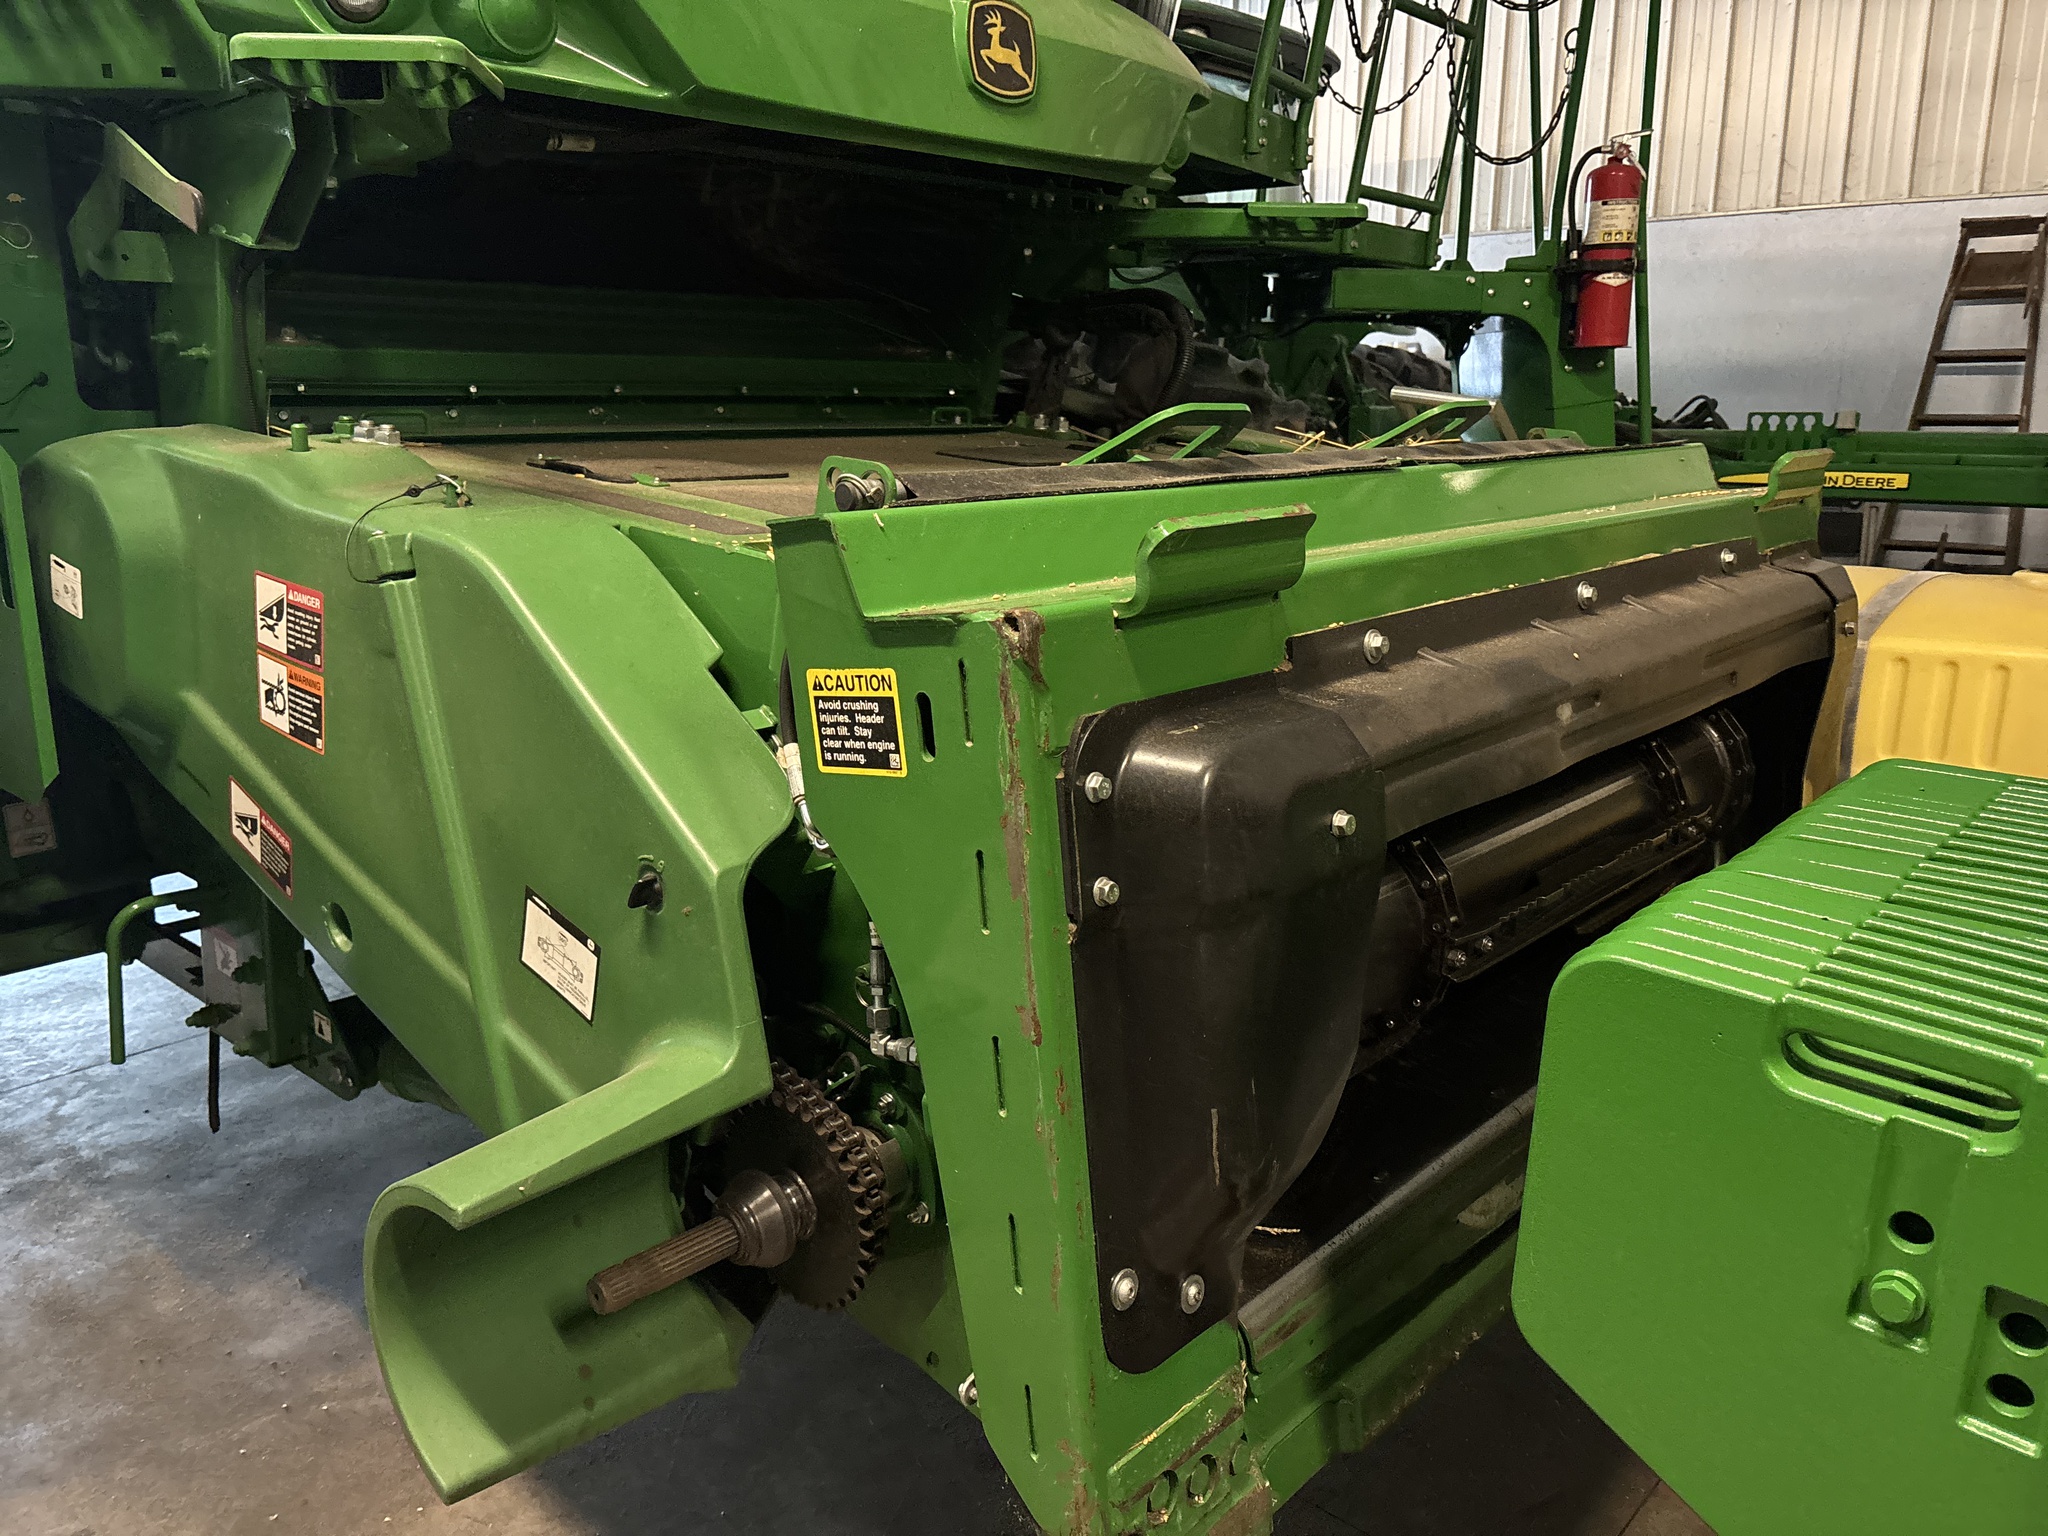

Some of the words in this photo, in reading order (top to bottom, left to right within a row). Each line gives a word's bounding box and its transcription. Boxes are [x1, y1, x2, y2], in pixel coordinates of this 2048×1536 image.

[1843, 475, 1897, 488] DEERE
[293, 591, 321, 609] DANGER
[293, 673, 321, 691] WARNING
[823, 674, 893, 692] CAUTION
[818, 699, 841, 710] Avoid
[842, 699, 879, 713] crushing
[819, 713, 852, 725] injuries.
[855, 713, 885, 724] Header
[821, 727, 836, 735] can
[837, 726, 850, 736] tilt.
[854, 726, 873, 738] Stay
[823, 738, 842, 748] clear
[844, 739, 866, 749] when
[867, 740, 896, 752] engine
[824, 751, 832, 760] is
[833, 753, 867, 765] running.
